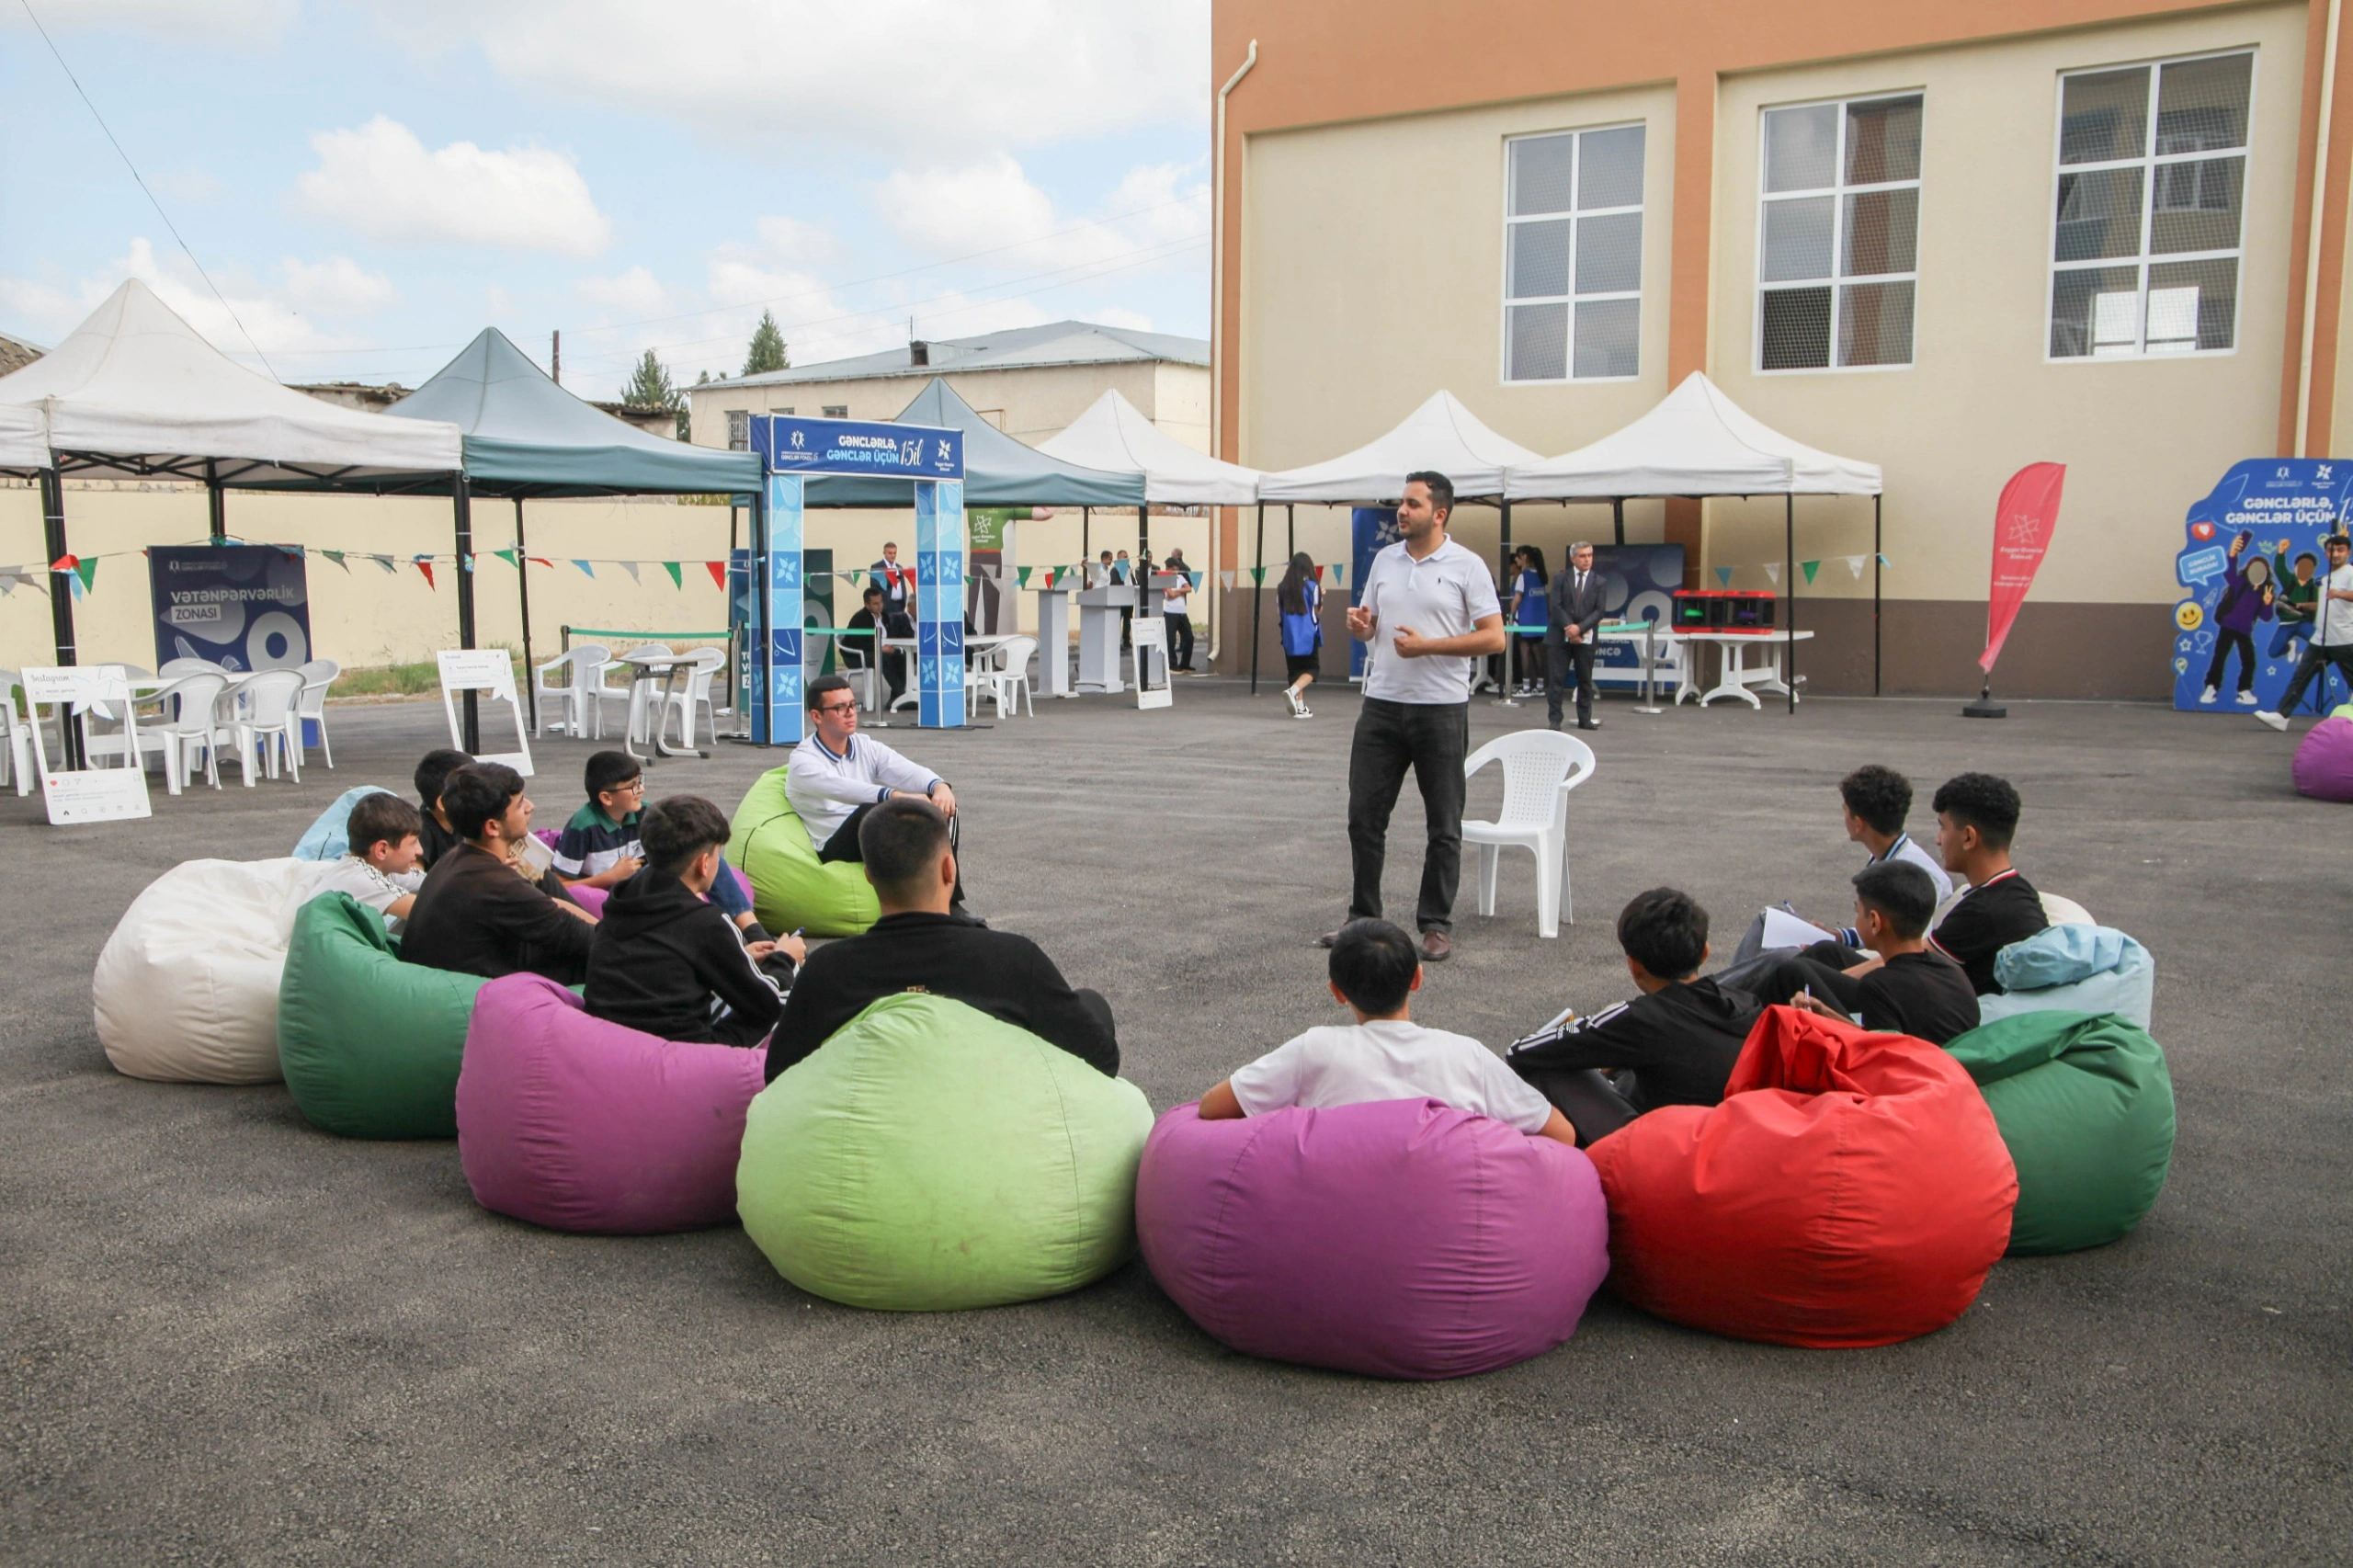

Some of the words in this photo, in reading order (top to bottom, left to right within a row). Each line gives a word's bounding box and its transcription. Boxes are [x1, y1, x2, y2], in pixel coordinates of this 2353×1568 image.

[838, 436, 897, 451] GƏNCLƏRLƏ,
[826, 449, 872, 461] GƏNCLƏR
[874, 449, 900, 466] ÜÇÜN
[2244, 497, 2334, 510] GƏNCLƏRLƏ,
[2225, 511, 2293, 524] GƏNCLƏR
[2295, 509, 2336, 527] ÜÇÜN
[170, 585, 295, 604] VƏTƏNPƏRVƏRLİK
[176, 607, 218, 620] ZONASI
[30, 674, 70, 684] Instagram
